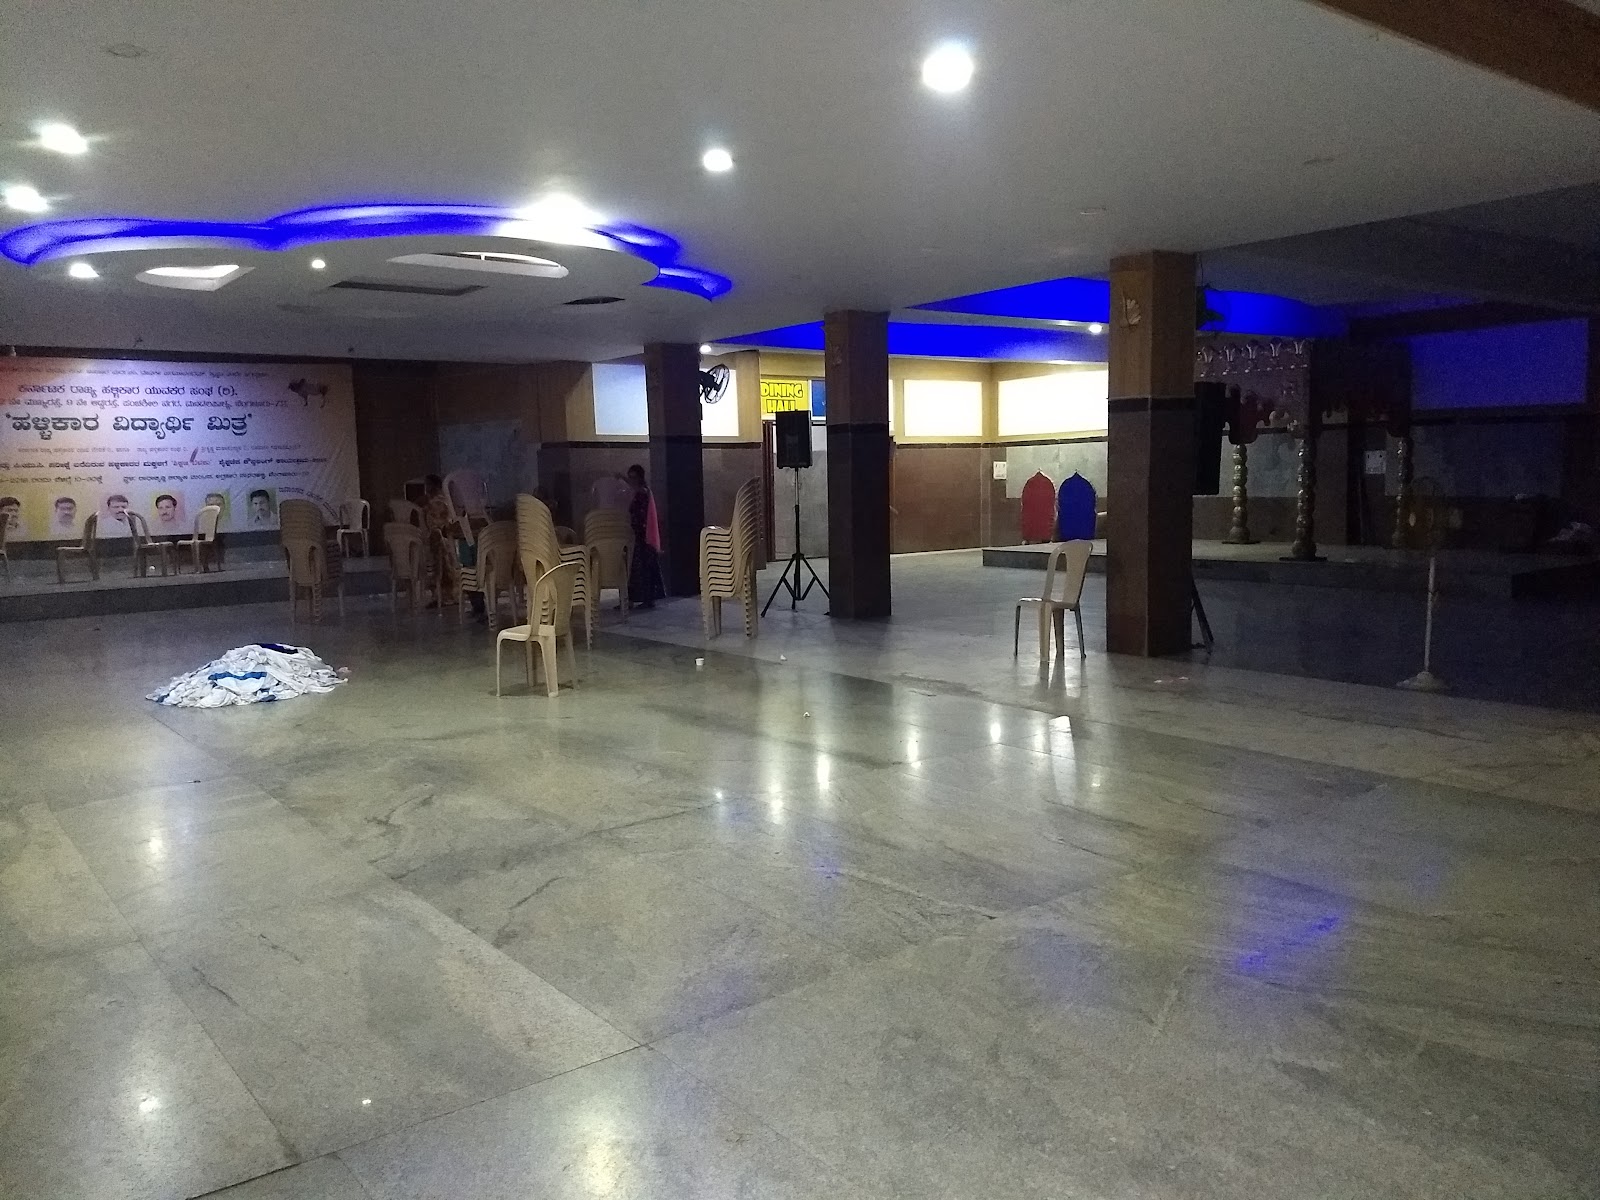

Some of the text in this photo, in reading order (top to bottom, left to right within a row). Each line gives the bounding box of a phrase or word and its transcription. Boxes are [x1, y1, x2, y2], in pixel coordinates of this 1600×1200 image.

[760, 381, 803, 398] DINING
[766, 399, 798, 413] HALL
[112, 415, 194, 440] ವಿದ್ಯಾರ್ಥಿ
